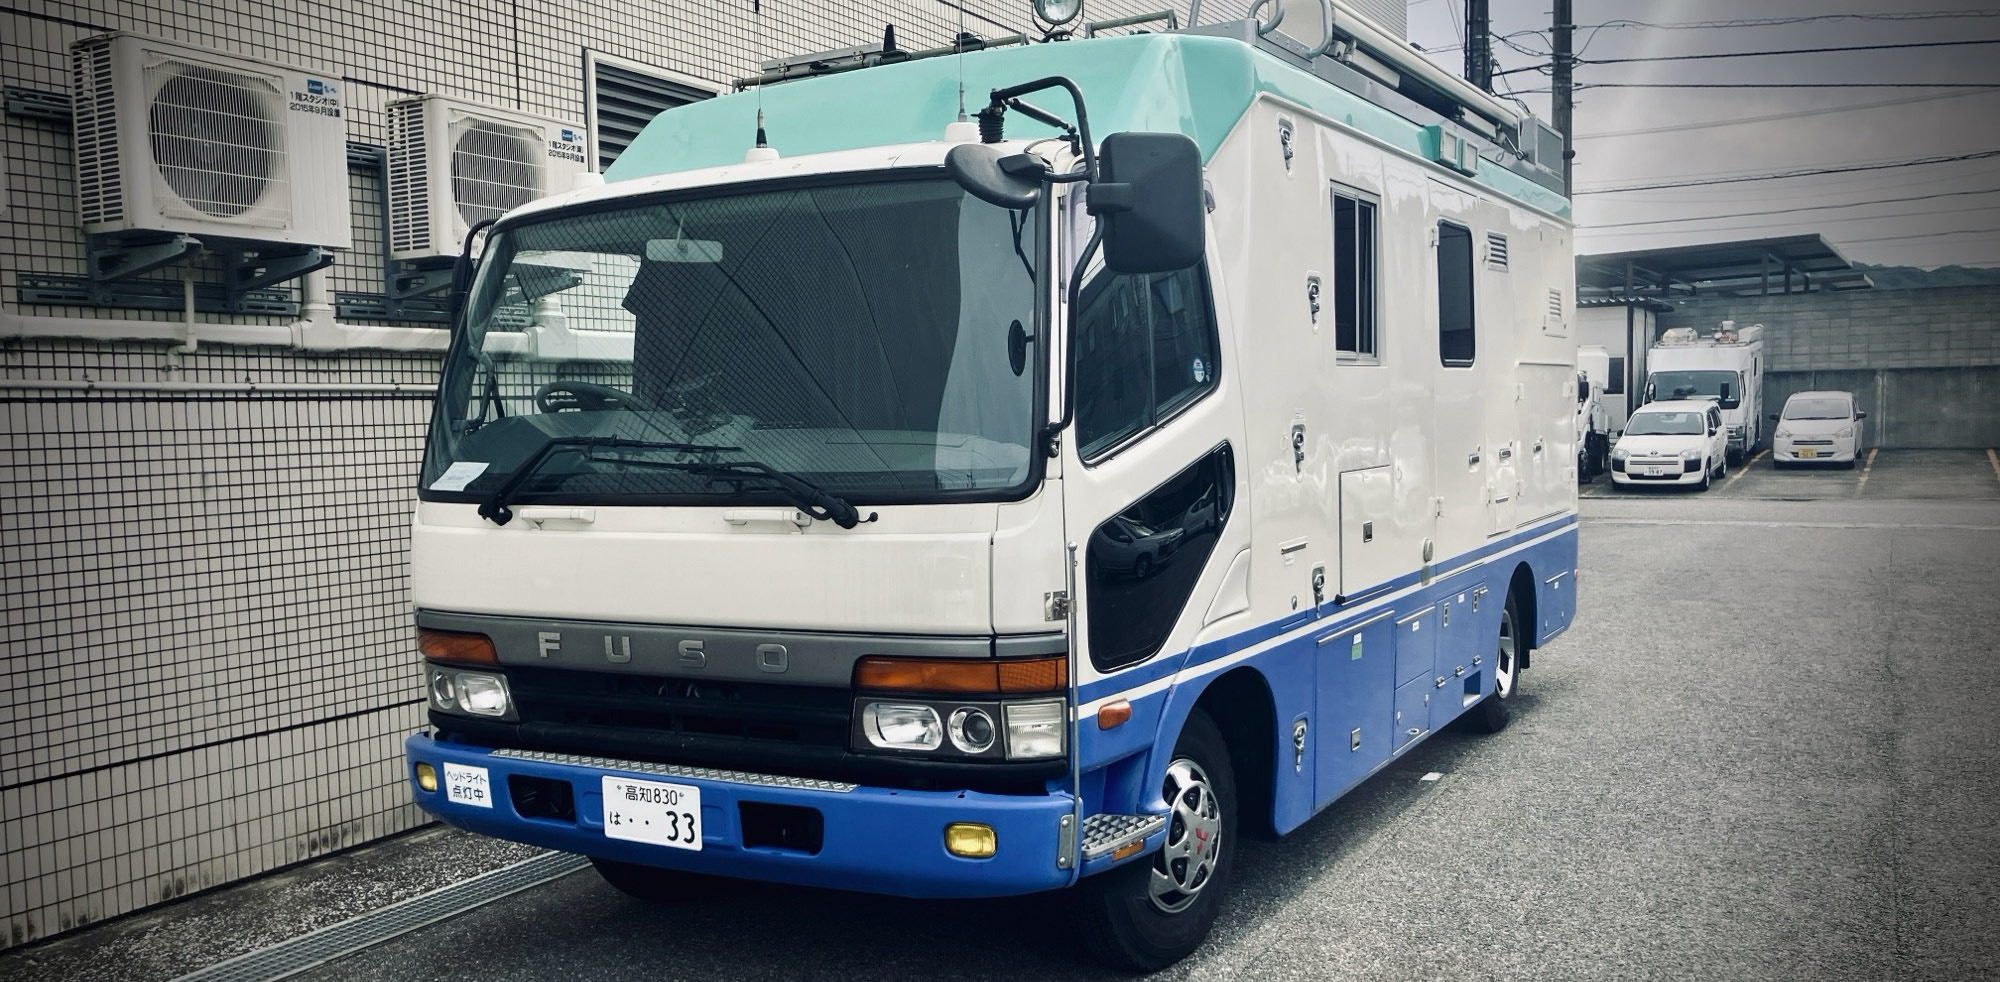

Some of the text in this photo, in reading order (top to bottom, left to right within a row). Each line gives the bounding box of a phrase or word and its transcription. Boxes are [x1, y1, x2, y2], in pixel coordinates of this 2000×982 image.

[538, 631, 789, 674] FUSO
[447, 771, 487, 785] ヘッドライト
[453, 785, 484, 801] 点灯中
[625, 785, 678, 806] 高知830
